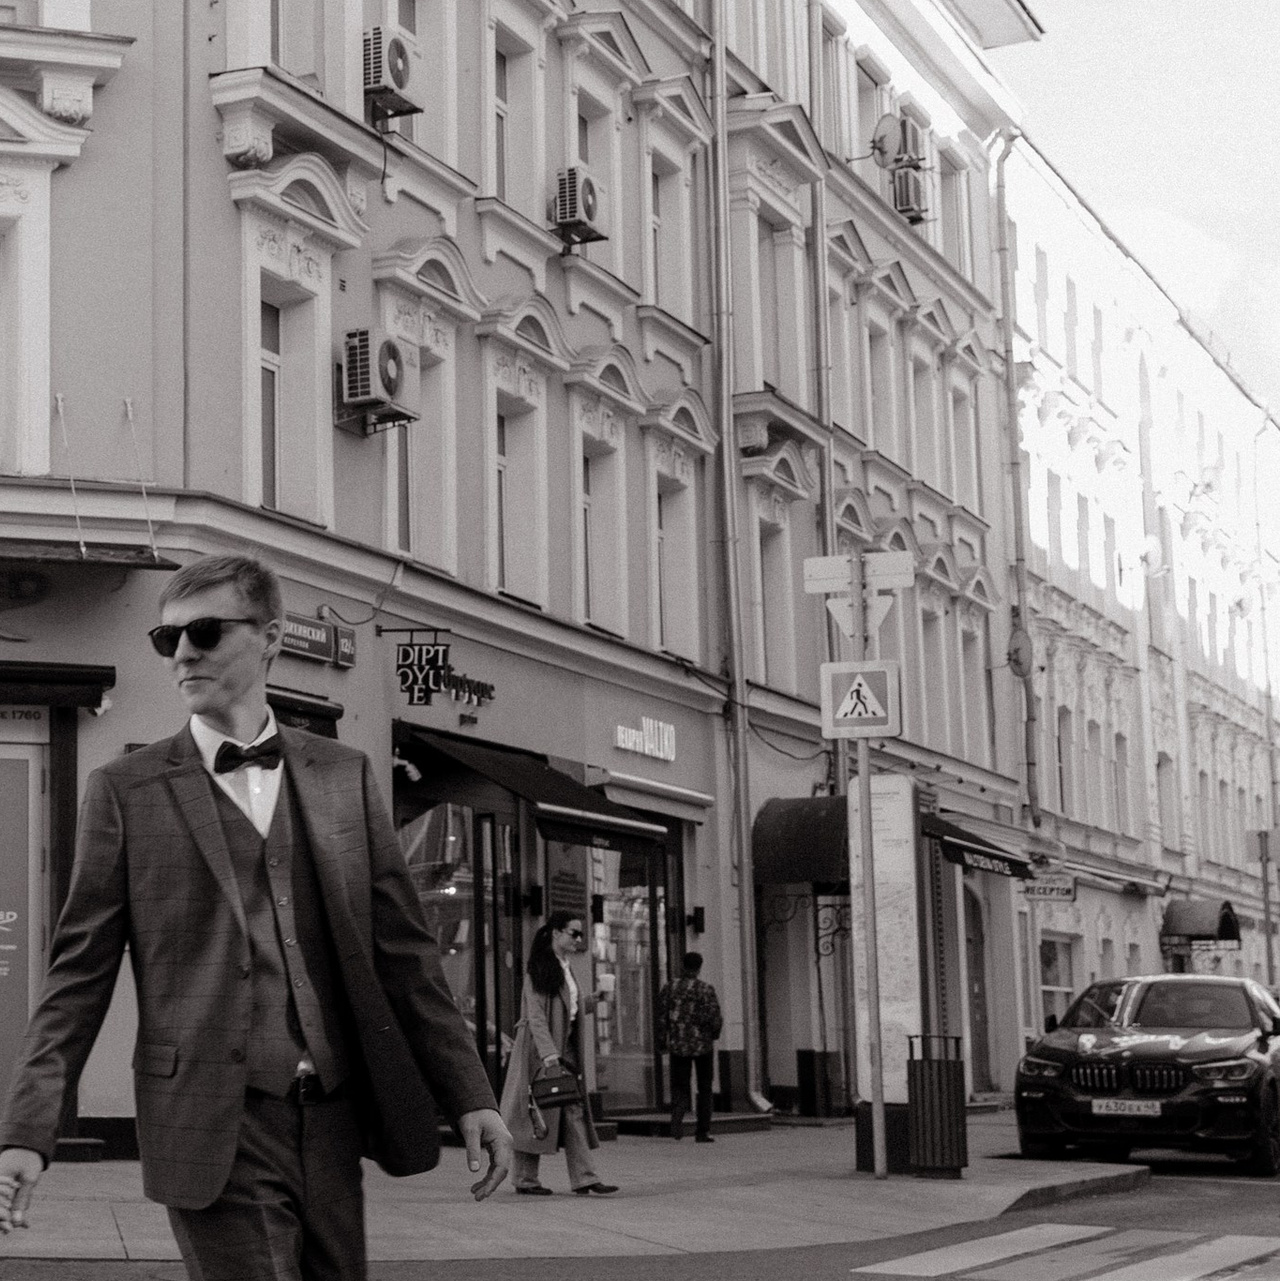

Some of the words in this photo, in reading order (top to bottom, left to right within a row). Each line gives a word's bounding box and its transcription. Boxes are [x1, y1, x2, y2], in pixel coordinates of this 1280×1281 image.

[283, 620, 327, 643] ЗИХИНСКИЙ
[398, 645, 447, 666] DIPT
[11, 710, 42, 720] 1760
